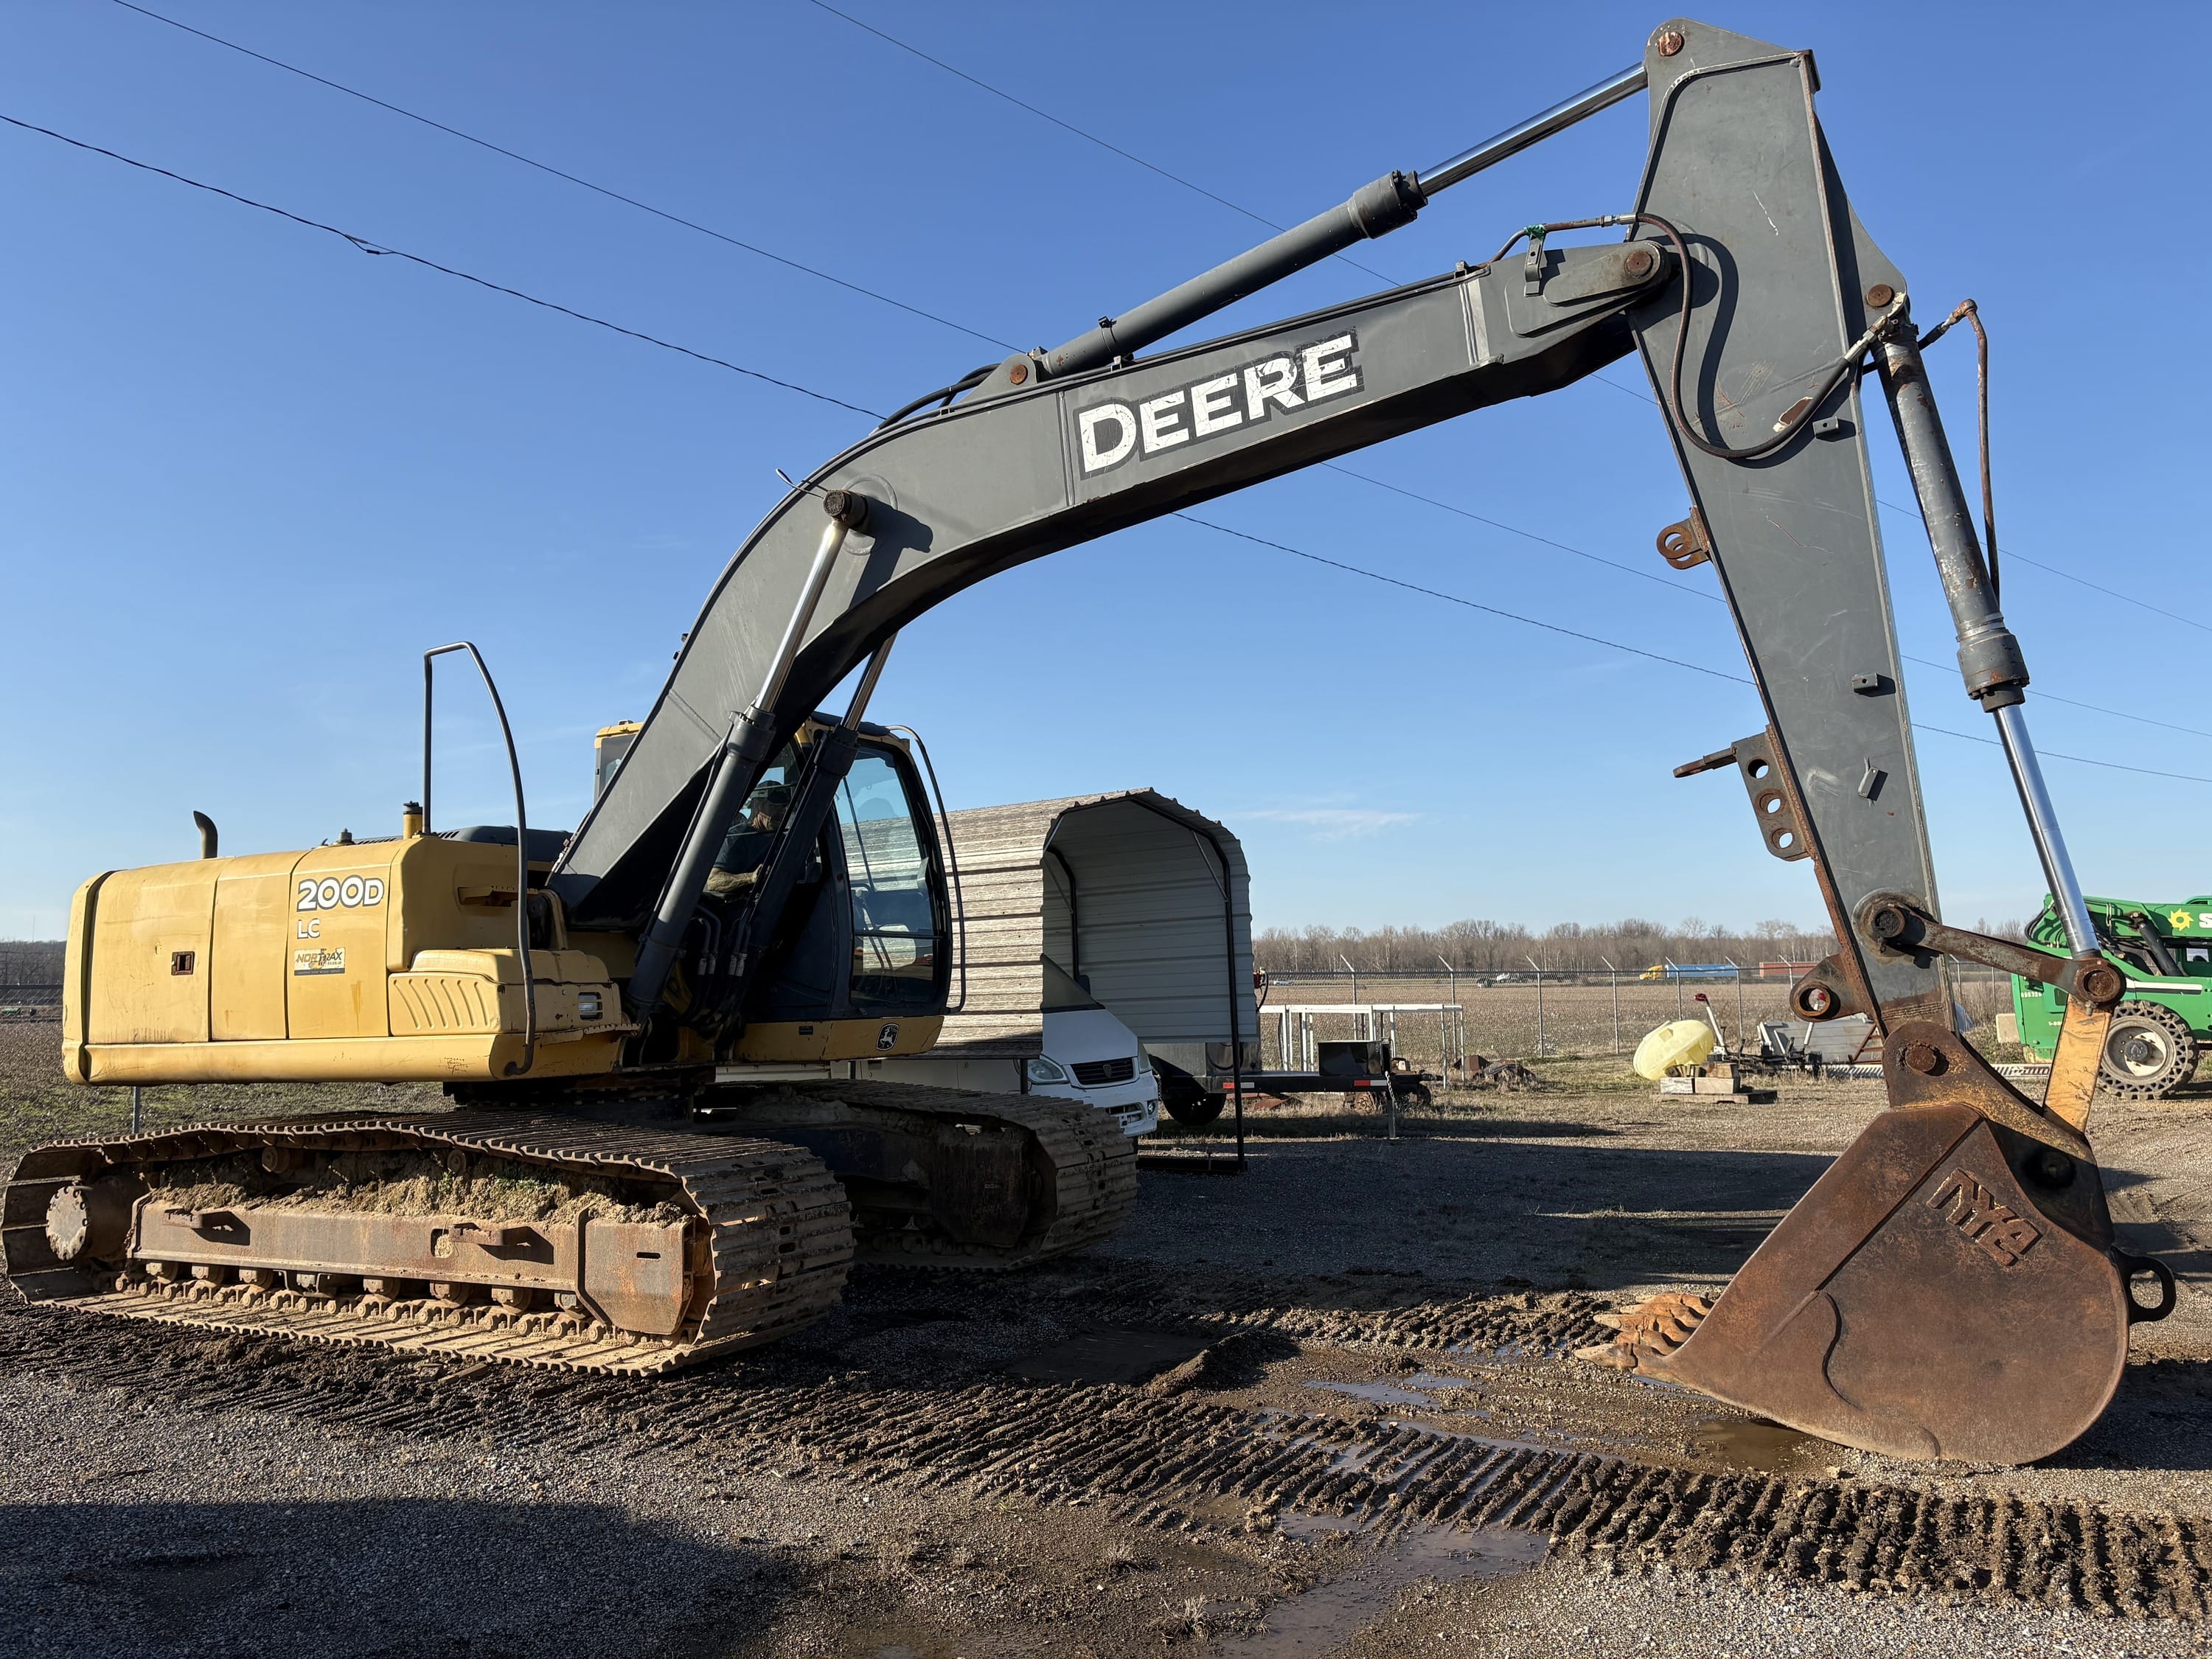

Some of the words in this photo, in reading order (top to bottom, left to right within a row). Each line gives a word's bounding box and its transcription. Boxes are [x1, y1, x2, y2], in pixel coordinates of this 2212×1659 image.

[1077, 332, 1360, 476] DEERE
[296, 875, 384, 912] 200D
[297, 919, 320, 939] LC
